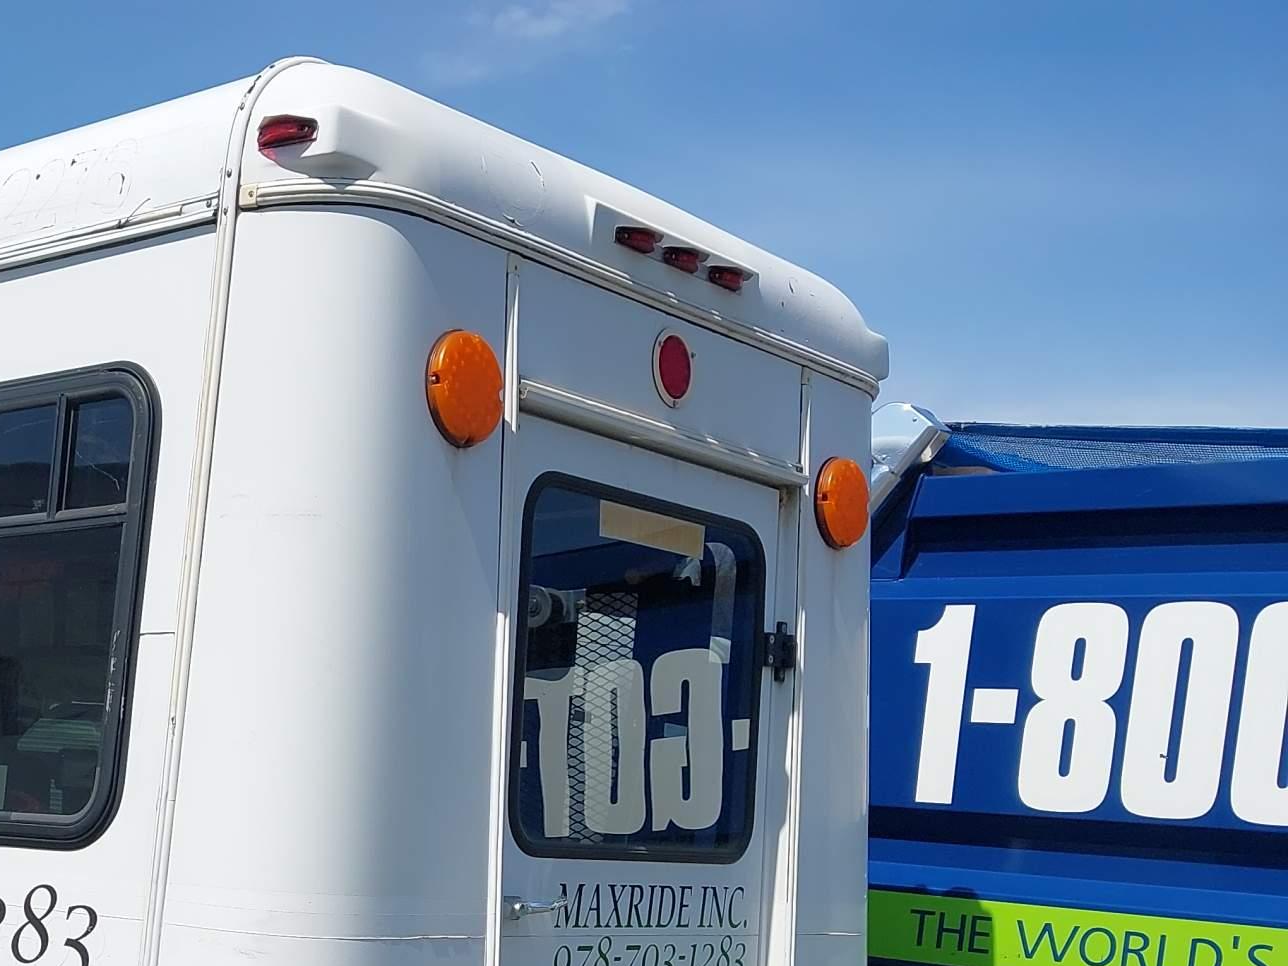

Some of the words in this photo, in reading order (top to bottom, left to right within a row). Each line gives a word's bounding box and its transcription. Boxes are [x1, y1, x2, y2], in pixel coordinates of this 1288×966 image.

[554, 883, 693, 929] MAXRIDE
[696, 886, 748, 929] INC.
[909, 908, 993, 956] THE
